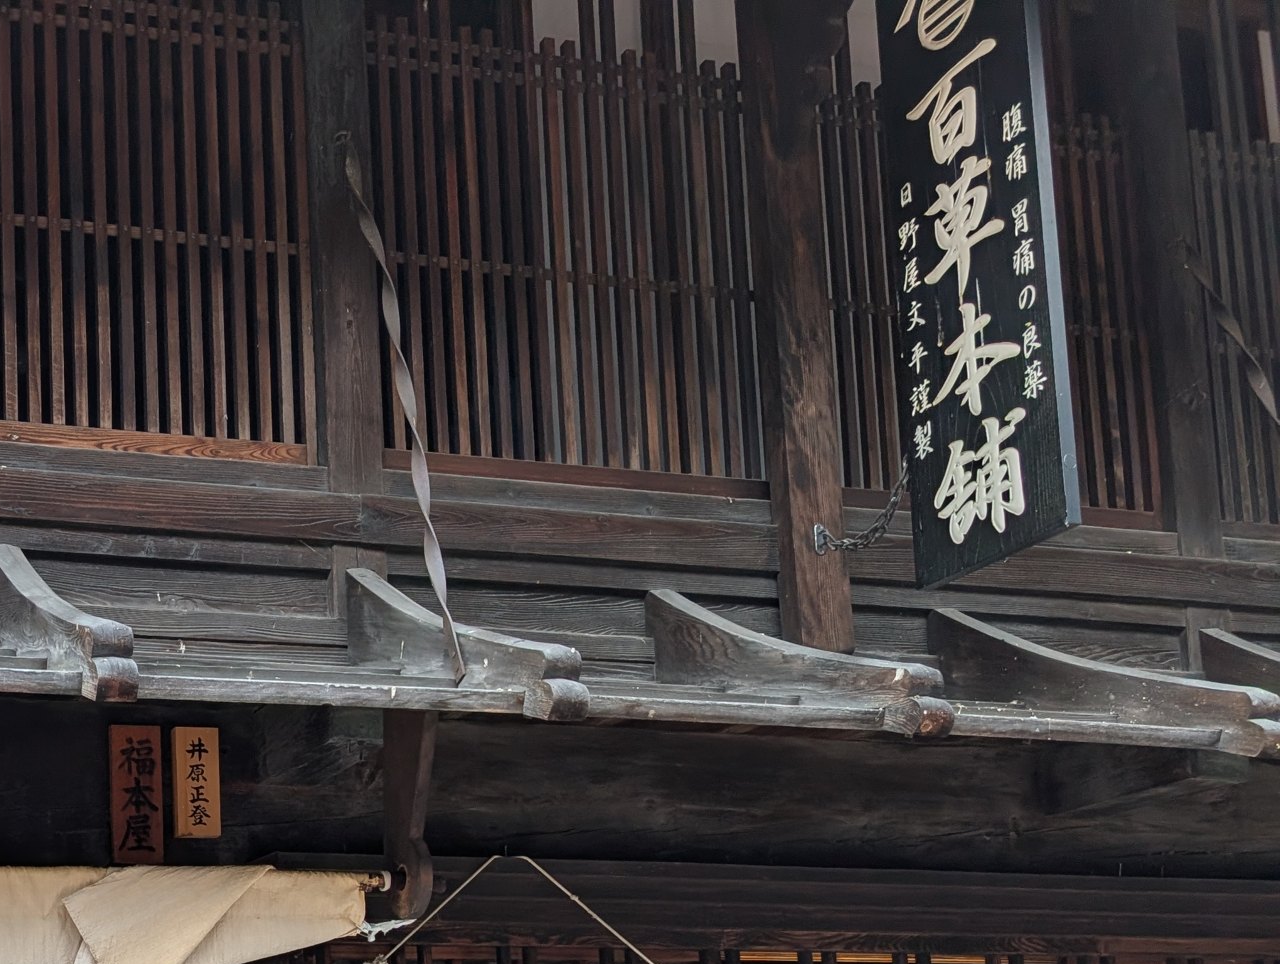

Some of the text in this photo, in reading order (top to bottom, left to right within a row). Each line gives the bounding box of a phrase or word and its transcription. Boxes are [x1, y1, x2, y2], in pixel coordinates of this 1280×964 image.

[898, 182, 934, 460] 日野屋文平謹製
[906, 38, 1026, 546] 百草本舗
[118, 736, 159, 853] 福本屋
[185, 737, 212, 826] 井原正登
